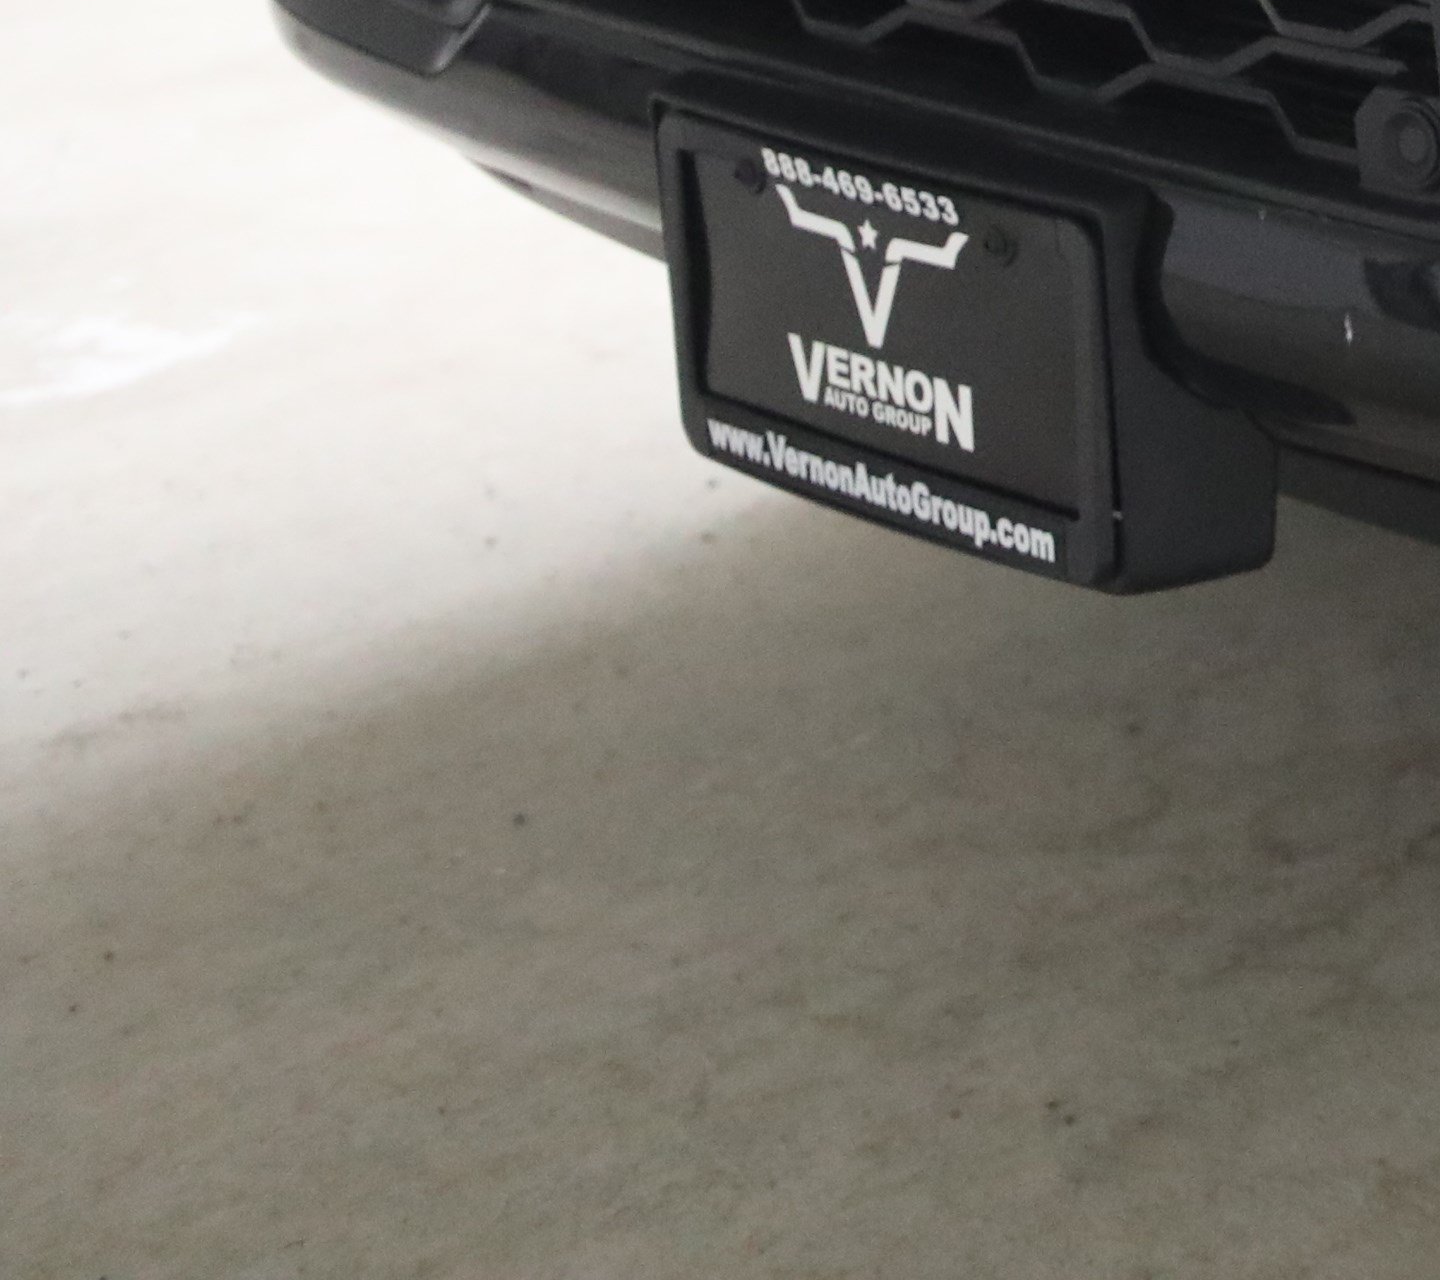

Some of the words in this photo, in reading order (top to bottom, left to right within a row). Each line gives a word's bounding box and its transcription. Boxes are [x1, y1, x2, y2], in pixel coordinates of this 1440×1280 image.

[761, 147, 960, 227] 888-469-6533
[787, 332, 975, 452] VERNON
[824, 386, 870, 420] AUTO
[873, 401, 933, 437] GROUP
[707, 418, 1056, 564] www.VernonAutoGroup.com
